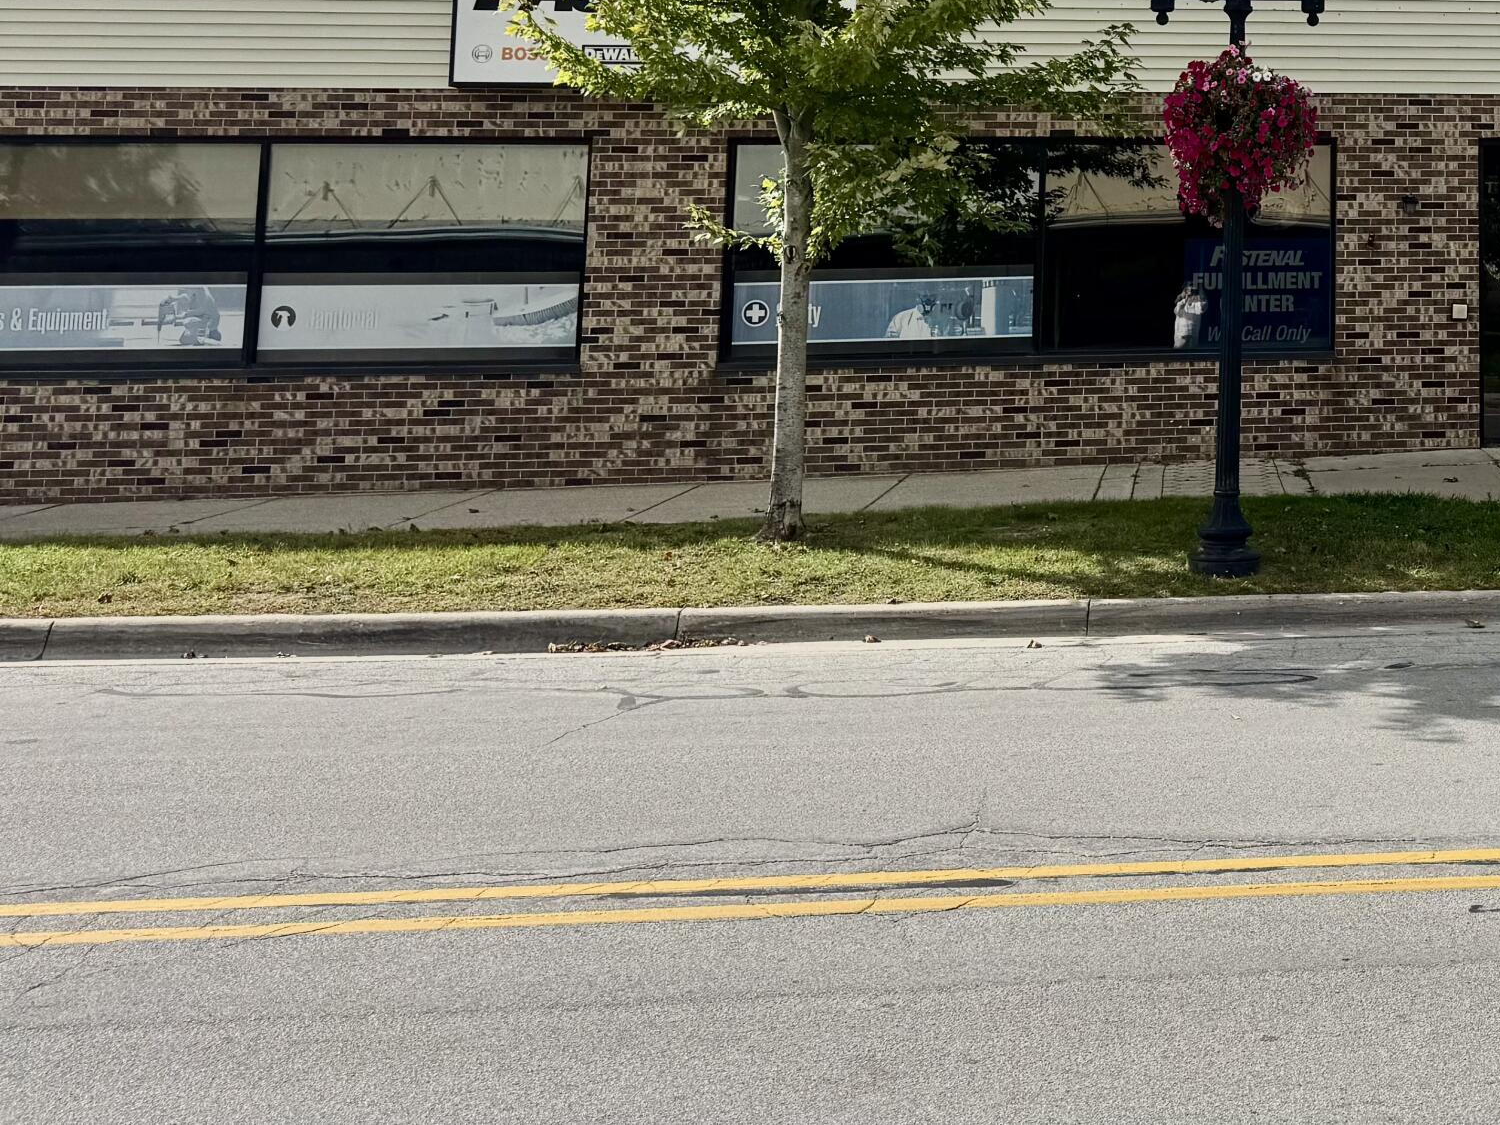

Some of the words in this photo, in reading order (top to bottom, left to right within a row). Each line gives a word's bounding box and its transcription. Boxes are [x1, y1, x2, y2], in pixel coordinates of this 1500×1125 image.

[584, 47, 641, 62] DEWAL
[1210, 245, 1305, 266] FSTENAL
[1220, 295, 1294, 313] NTER
[10, 307, 23, 331] &
[28, 307, 108, 335] Equipment
[1241, 325, 1271, 341] Call
[1276, 324, 1312, 343] Only
